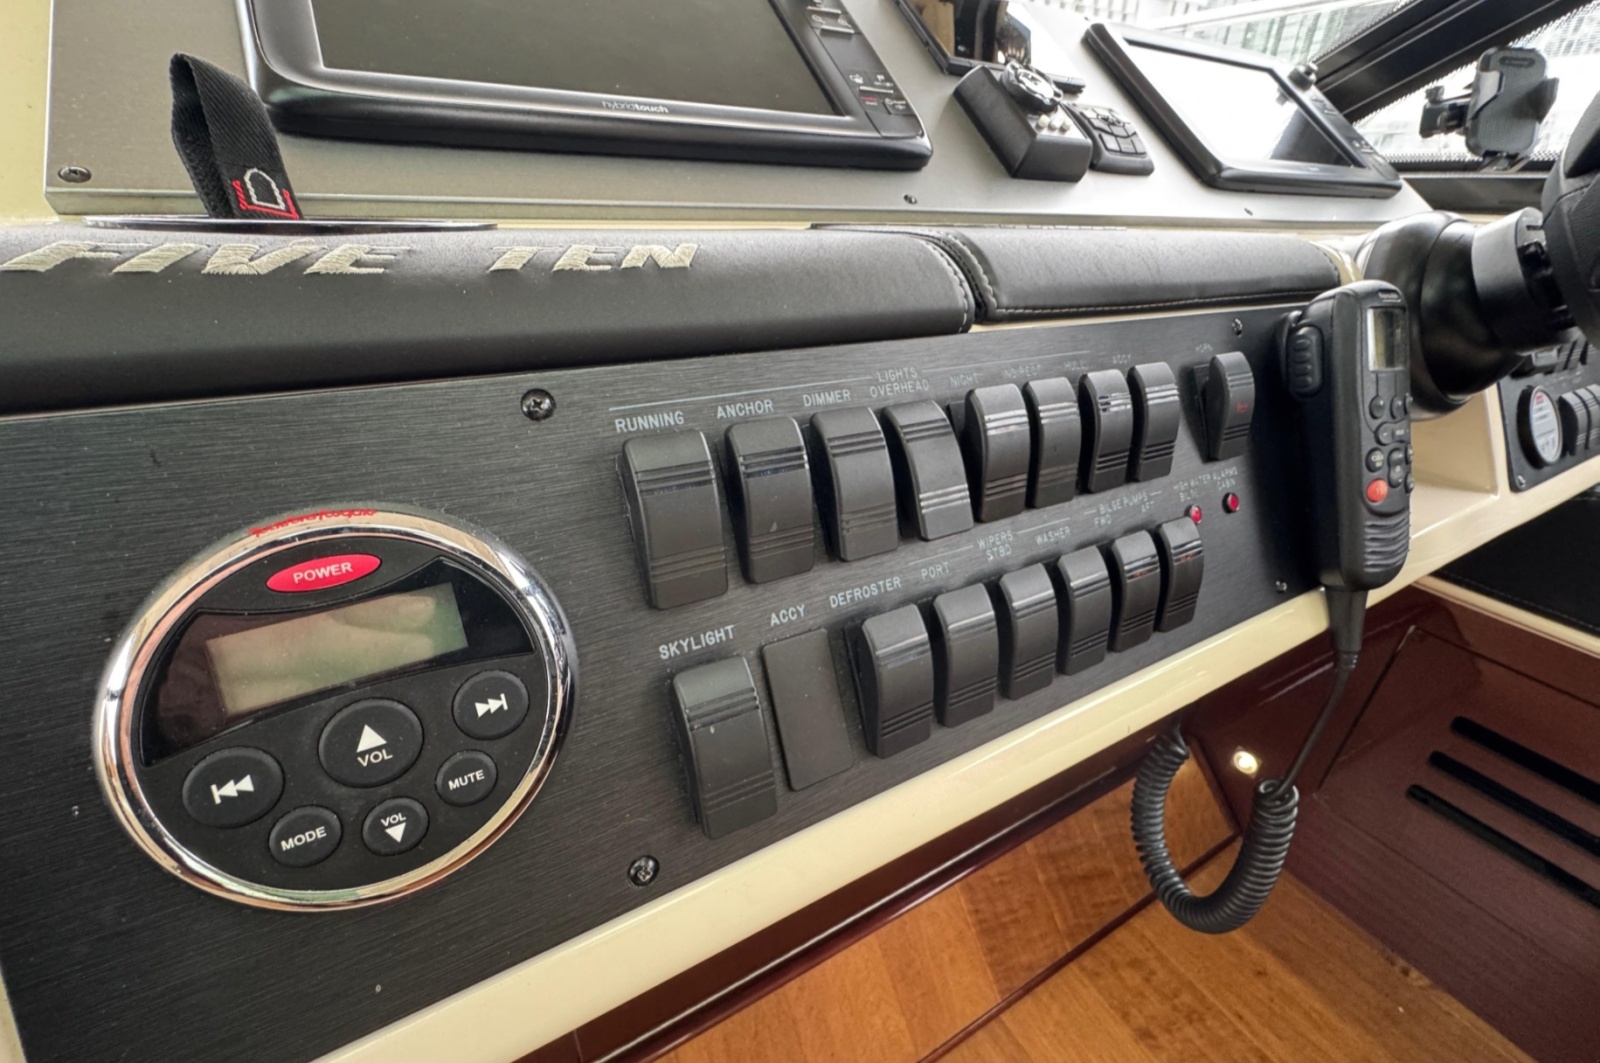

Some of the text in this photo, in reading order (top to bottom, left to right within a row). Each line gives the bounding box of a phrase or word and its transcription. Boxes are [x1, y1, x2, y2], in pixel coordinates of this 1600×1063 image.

[601, 100, 669, 114] hybridtouch
[0, 240, 700, 276] FIVE TEN
[876, 367, 919, 384] LIGHTS
[802, 389, 851, 408] DIMMER
[869, 379, 930, 399] OVERHEAD
[715, 399, 774, 420] ANCHOR
[614, 410, 685, 434] RUNNING
[977, 529, 1014, 549] WIPERS
[1035, 525, 1071, 545] WASHER
[985, 543, 1013, 562] STBD
[292, 561, 354, 584] POWER
[920, 561, 951, 581] PORT
[829, 576, 902, 608] DEFROSTER
[770, 603, 806, 627] ACCY
[658, 624, 735, 660] SKYLIGHT
[357, 749, 394, 769] VOL
[448, 769, 485, 791] MUTE
[380, 812, 407, 828] VOL
[280, 826, 328, 851] MODE
